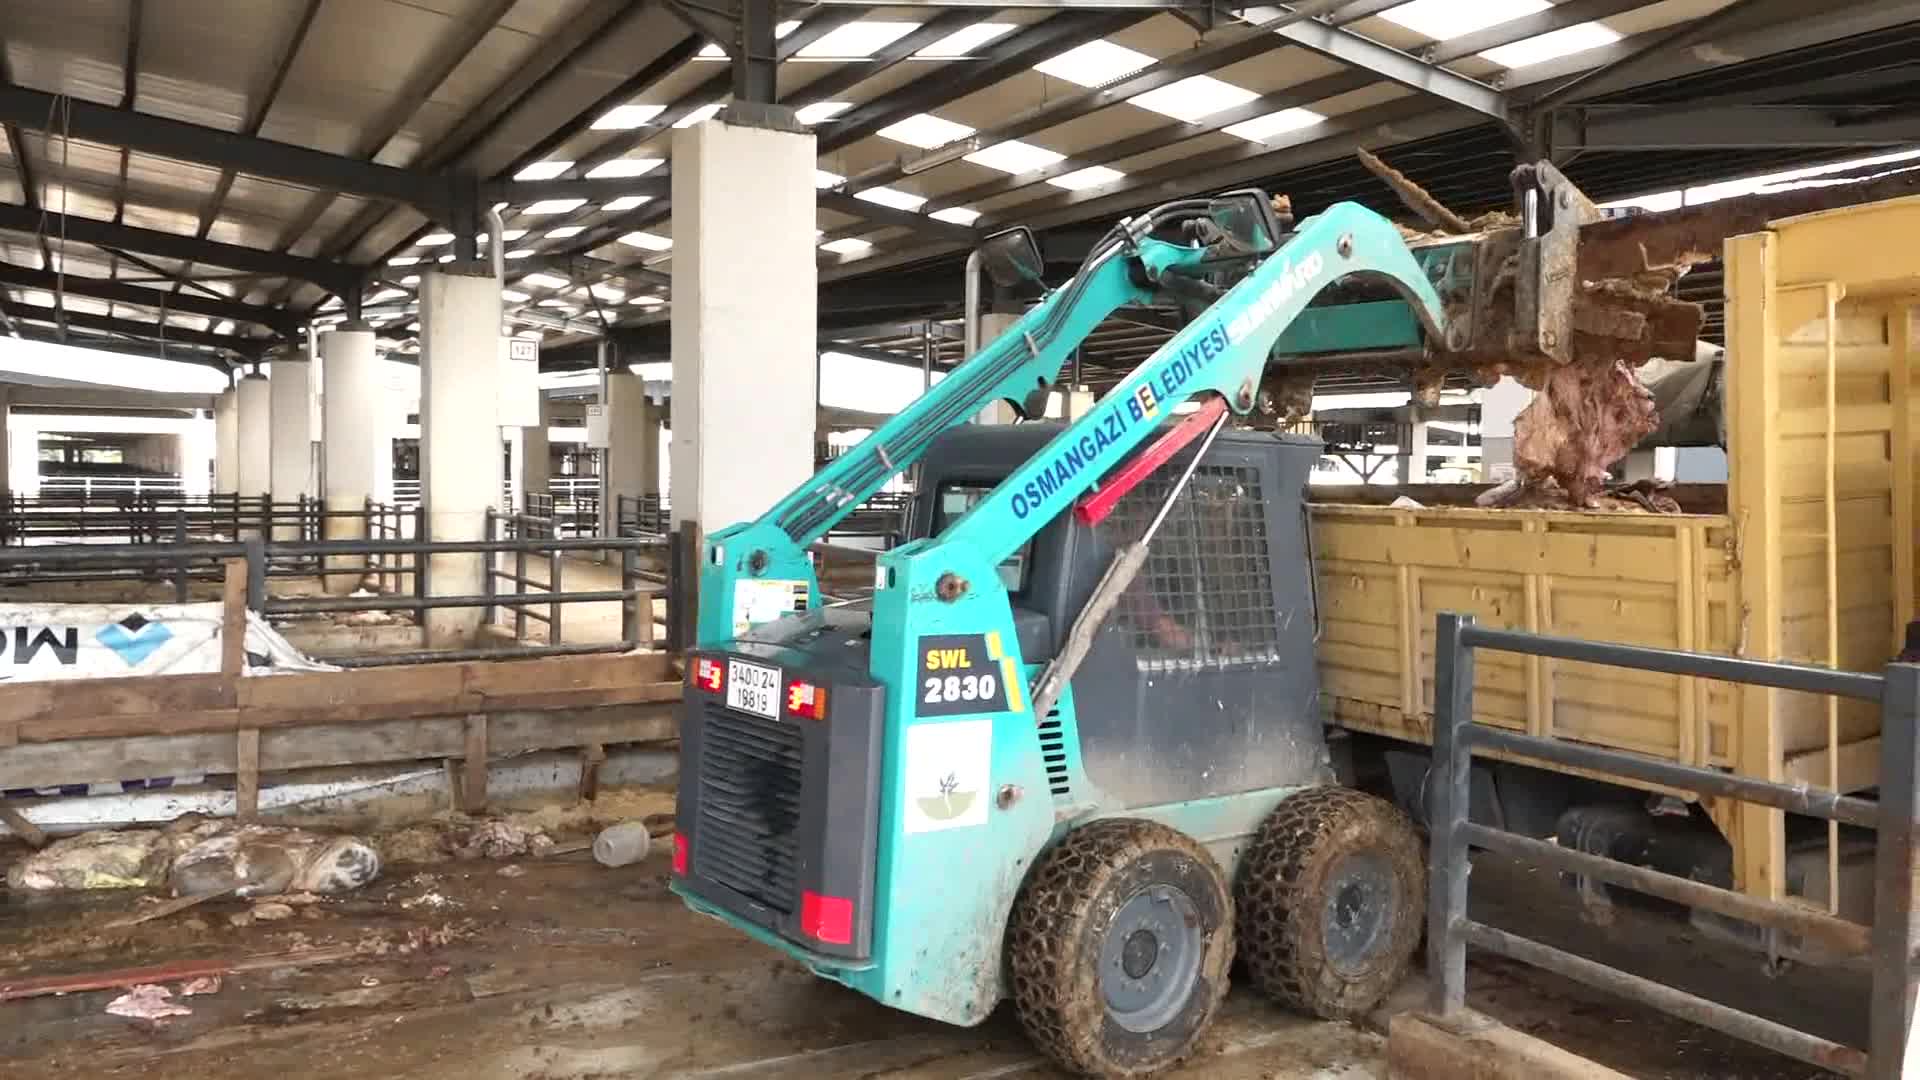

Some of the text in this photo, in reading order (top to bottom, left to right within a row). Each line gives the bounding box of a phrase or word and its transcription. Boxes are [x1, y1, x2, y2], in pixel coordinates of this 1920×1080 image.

[1012, 318, 1230, 519] OSMANGAZİ BELEDİYESİ
[926, 649, 971, 670] SWL
[925, 675, 995, 703] 2830
